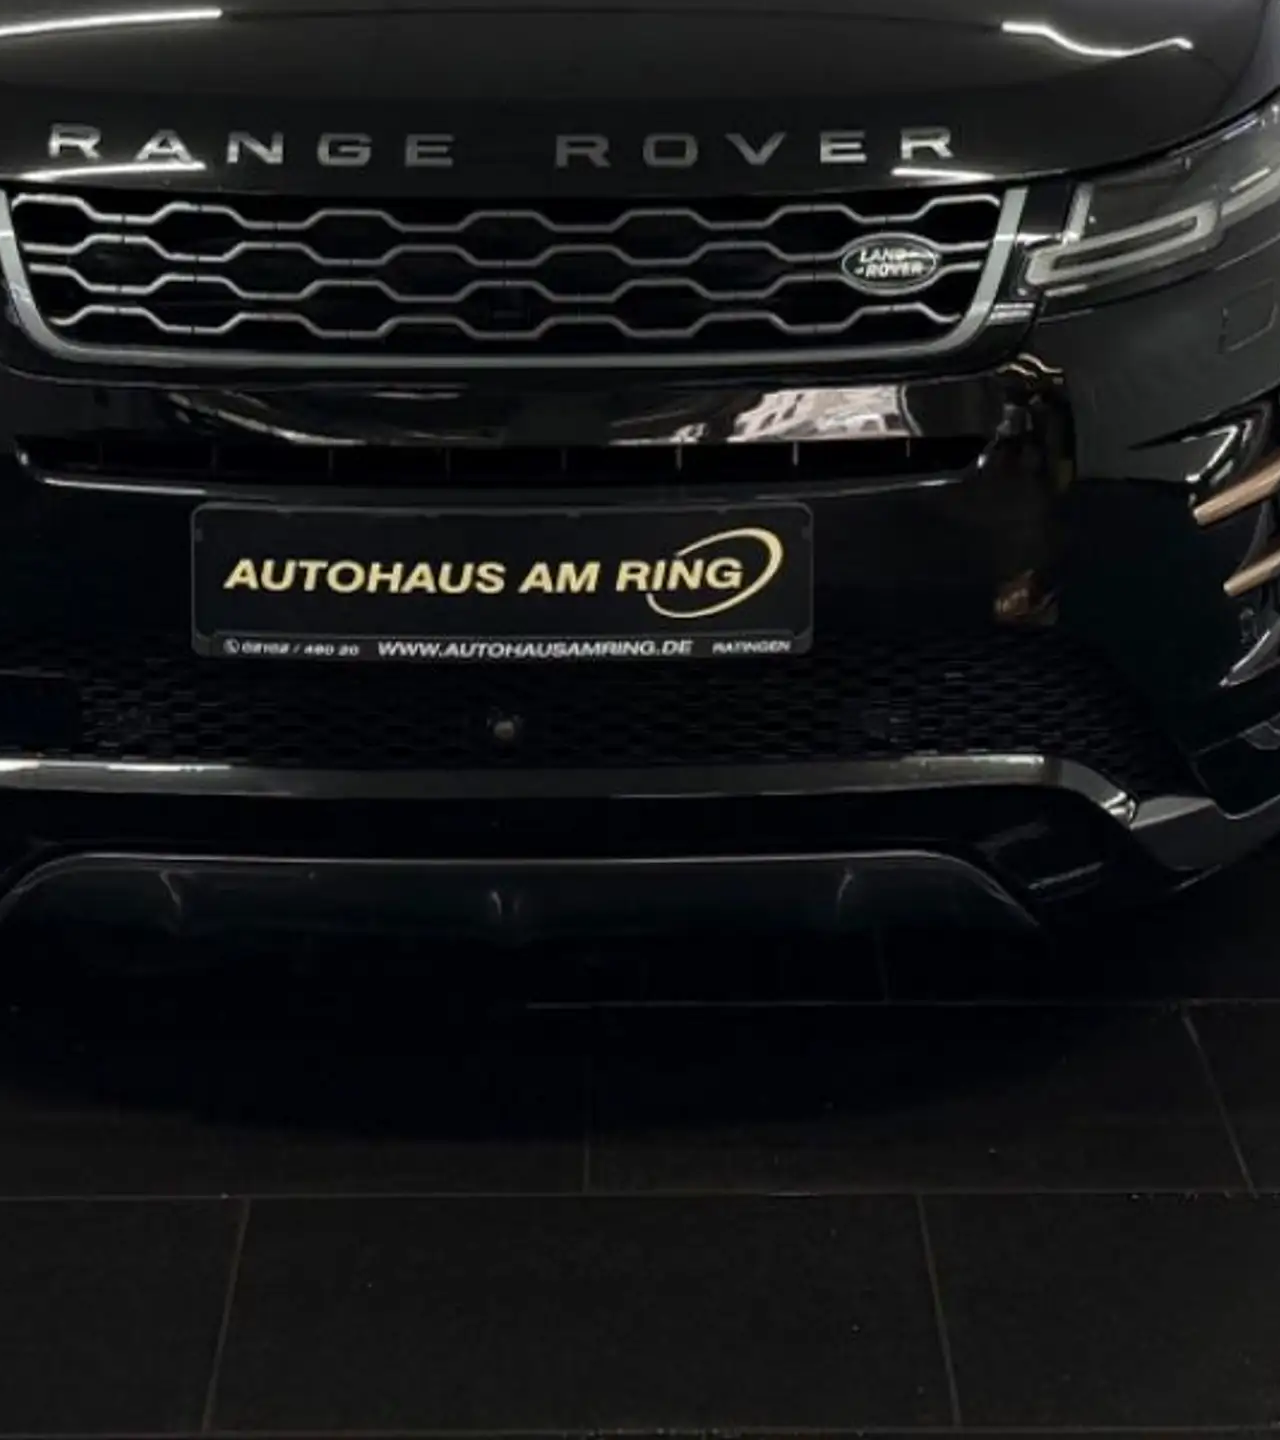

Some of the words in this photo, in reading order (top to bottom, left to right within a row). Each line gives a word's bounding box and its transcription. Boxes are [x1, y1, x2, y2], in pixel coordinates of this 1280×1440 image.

[47, 123, 455, 169] RANGE
[555, 124, 956, 169] ROVER
[859, 247, 908, 263] LAND
[864, 261, 925, 278] ROVER
[224, 558, 506, 595] AUTOHAUS
[518, 560, 601, 594] AM
[615, 557, 745, 592] RING
[377, 639, 694, 659] WWW.AUTOHAUSAMRING.DE
